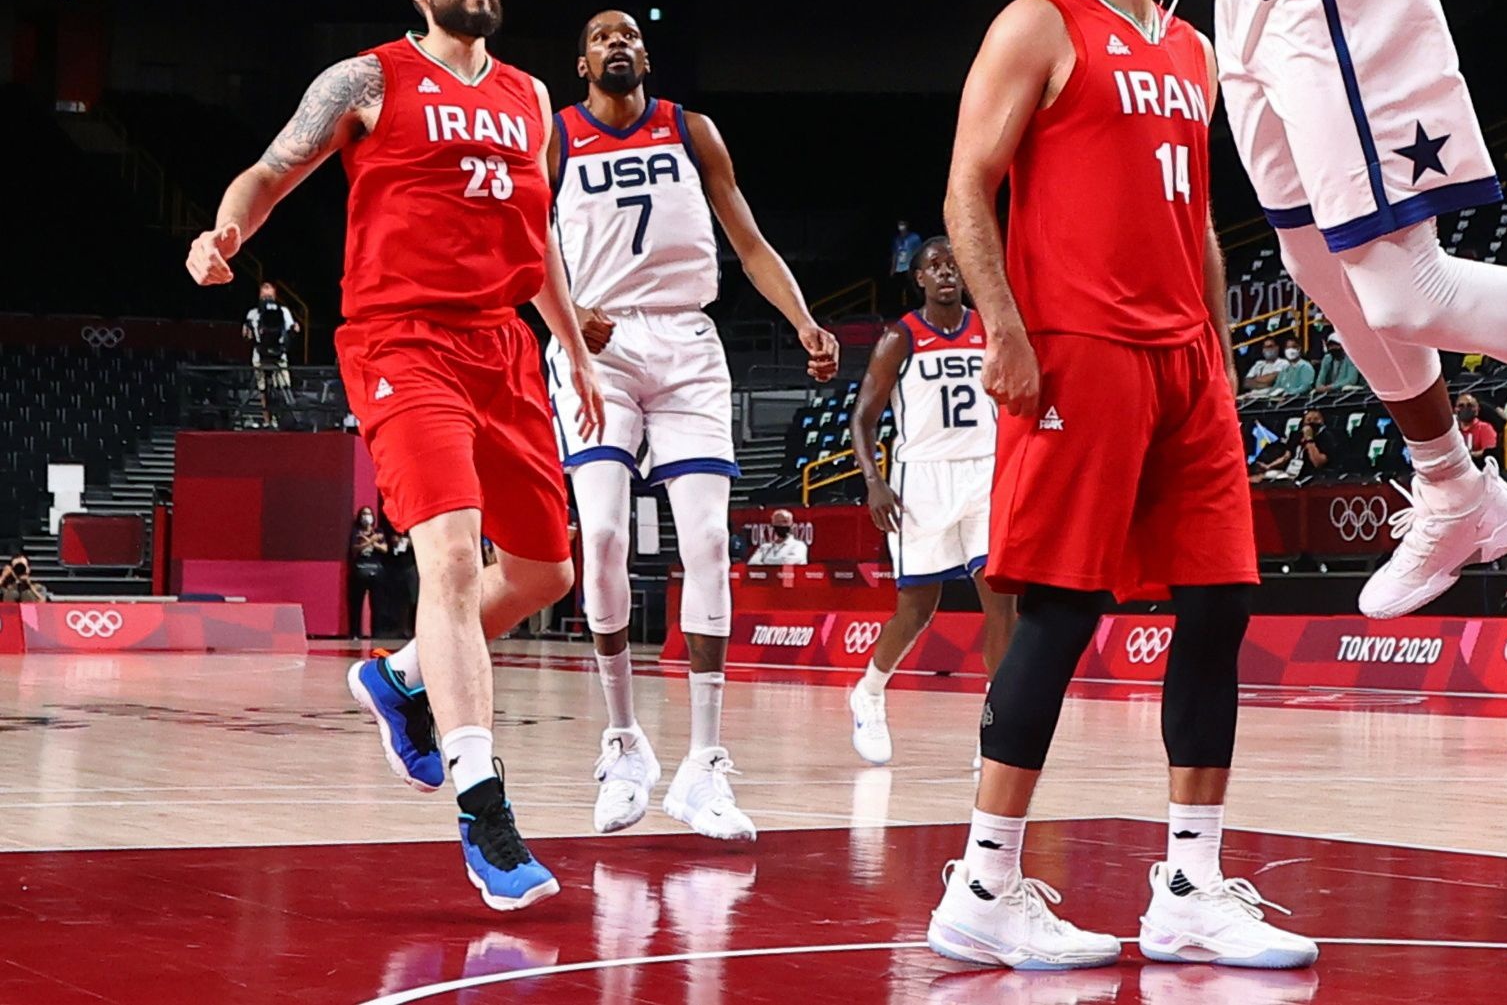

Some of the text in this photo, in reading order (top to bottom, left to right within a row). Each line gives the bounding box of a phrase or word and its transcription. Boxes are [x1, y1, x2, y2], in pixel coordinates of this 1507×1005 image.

[1112, 68, 1210, 127] IRAN
[424, 104, 529, 153] IRAN
[460, 156, 514, 201] 23
[578, 152, 681, 195] USA
[1155, 142, 1191, 205] 14
[616, 194, 653, 256] 7
[919, 356, 984, 381] USA
[940, 384, 978, 429] 12
[751, 625, 815, 647] TOKYO 2020
[1337, 636, 1443, 664] TOKYO 2020
